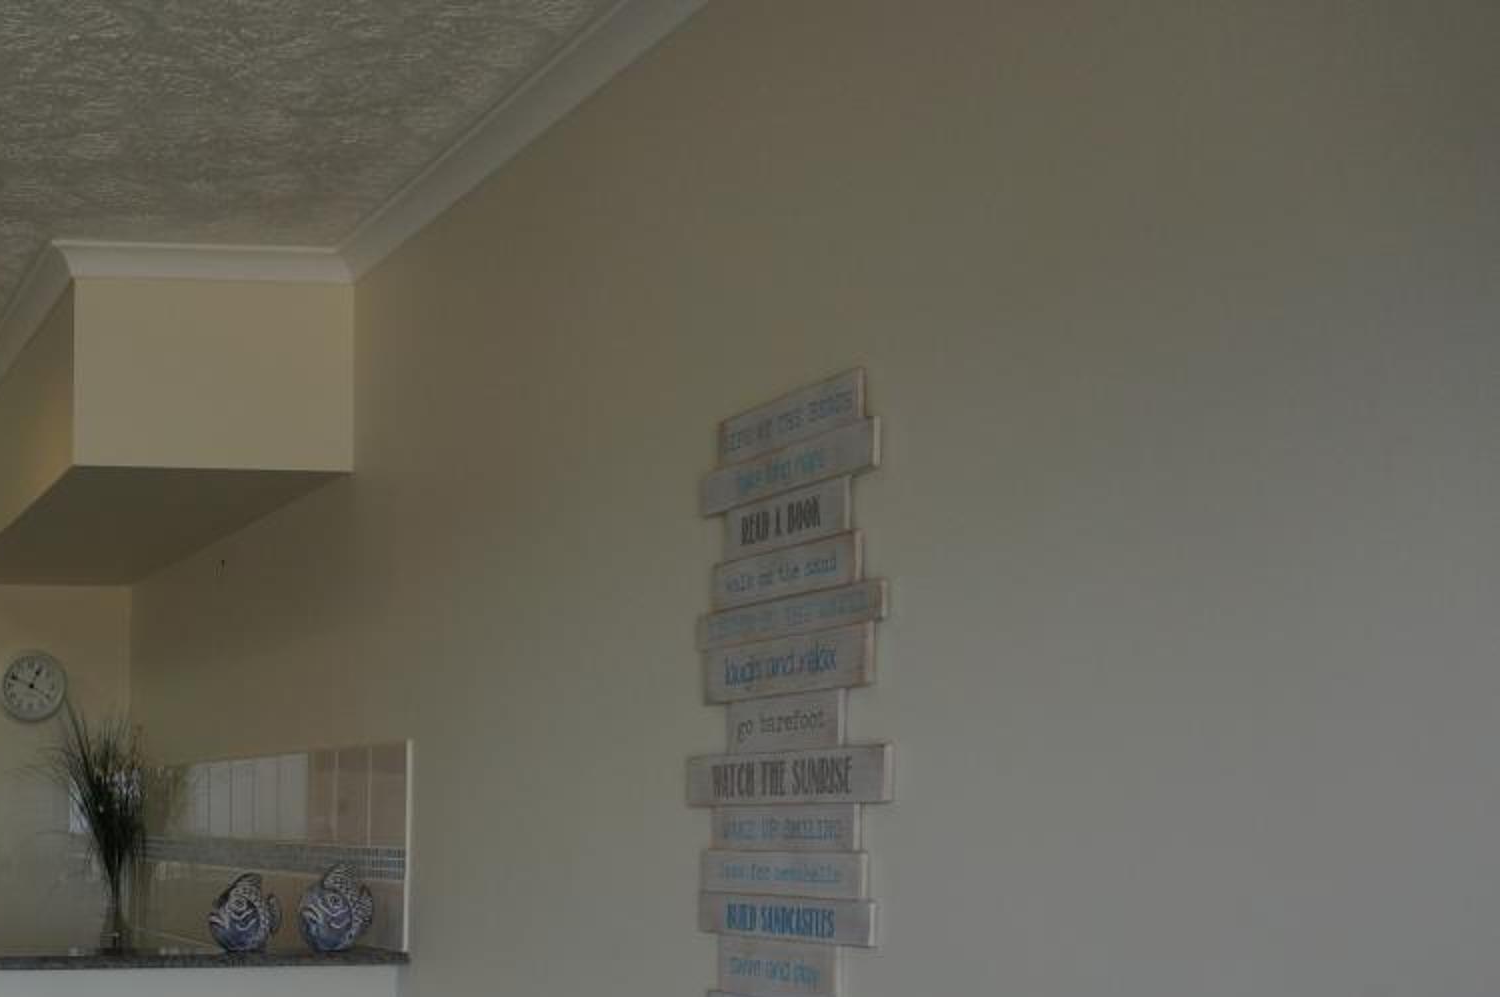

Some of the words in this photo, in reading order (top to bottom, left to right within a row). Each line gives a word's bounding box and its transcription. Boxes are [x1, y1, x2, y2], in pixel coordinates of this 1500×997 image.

[741, 511, 769, 546] READ
[775, 504, 784, 536] A
[787, 494, 821, 534] BOOK
[737, 718, 754, 744] go
[760, 708, 825, 734] barefoot
[711, 761, 755, 799] WATCH
[760, 759, 786, 797] THE
[791, 754, 853, 796] SUNRISE
[726, 902, 756, 932] BUILD
[761, 904, 836, 939] SANDCASTLES
